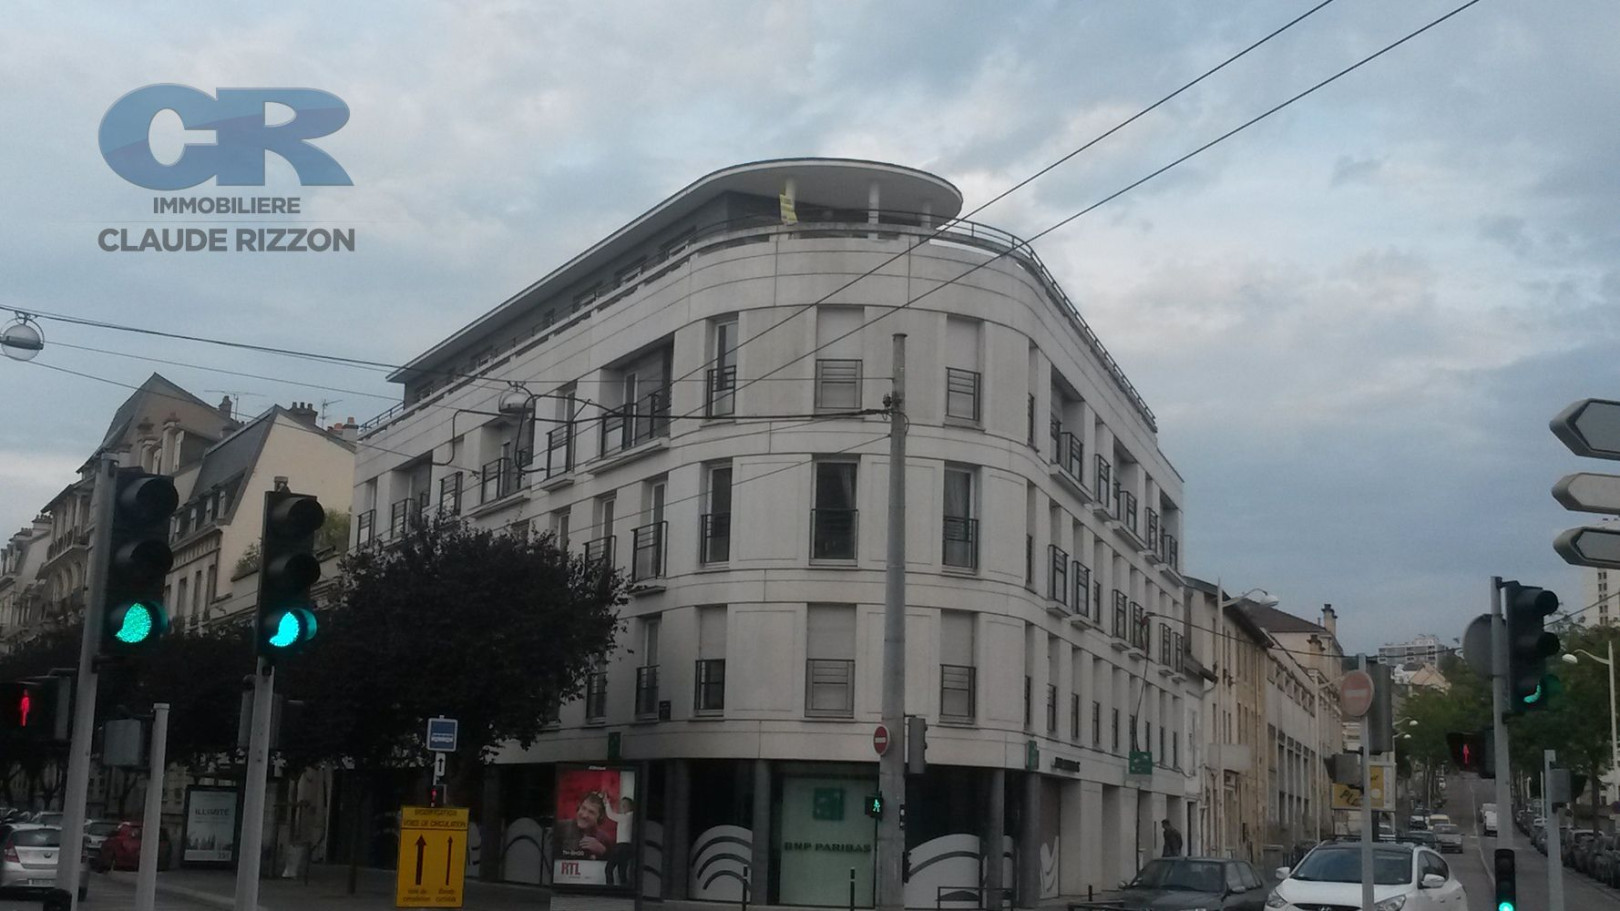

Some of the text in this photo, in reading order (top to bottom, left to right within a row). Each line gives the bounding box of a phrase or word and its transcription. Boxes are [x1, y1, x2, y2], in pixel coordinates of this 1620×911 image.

[784, 841, 871, 853] BNP PARIBAS
[561, 862, 581, 876] RTL
